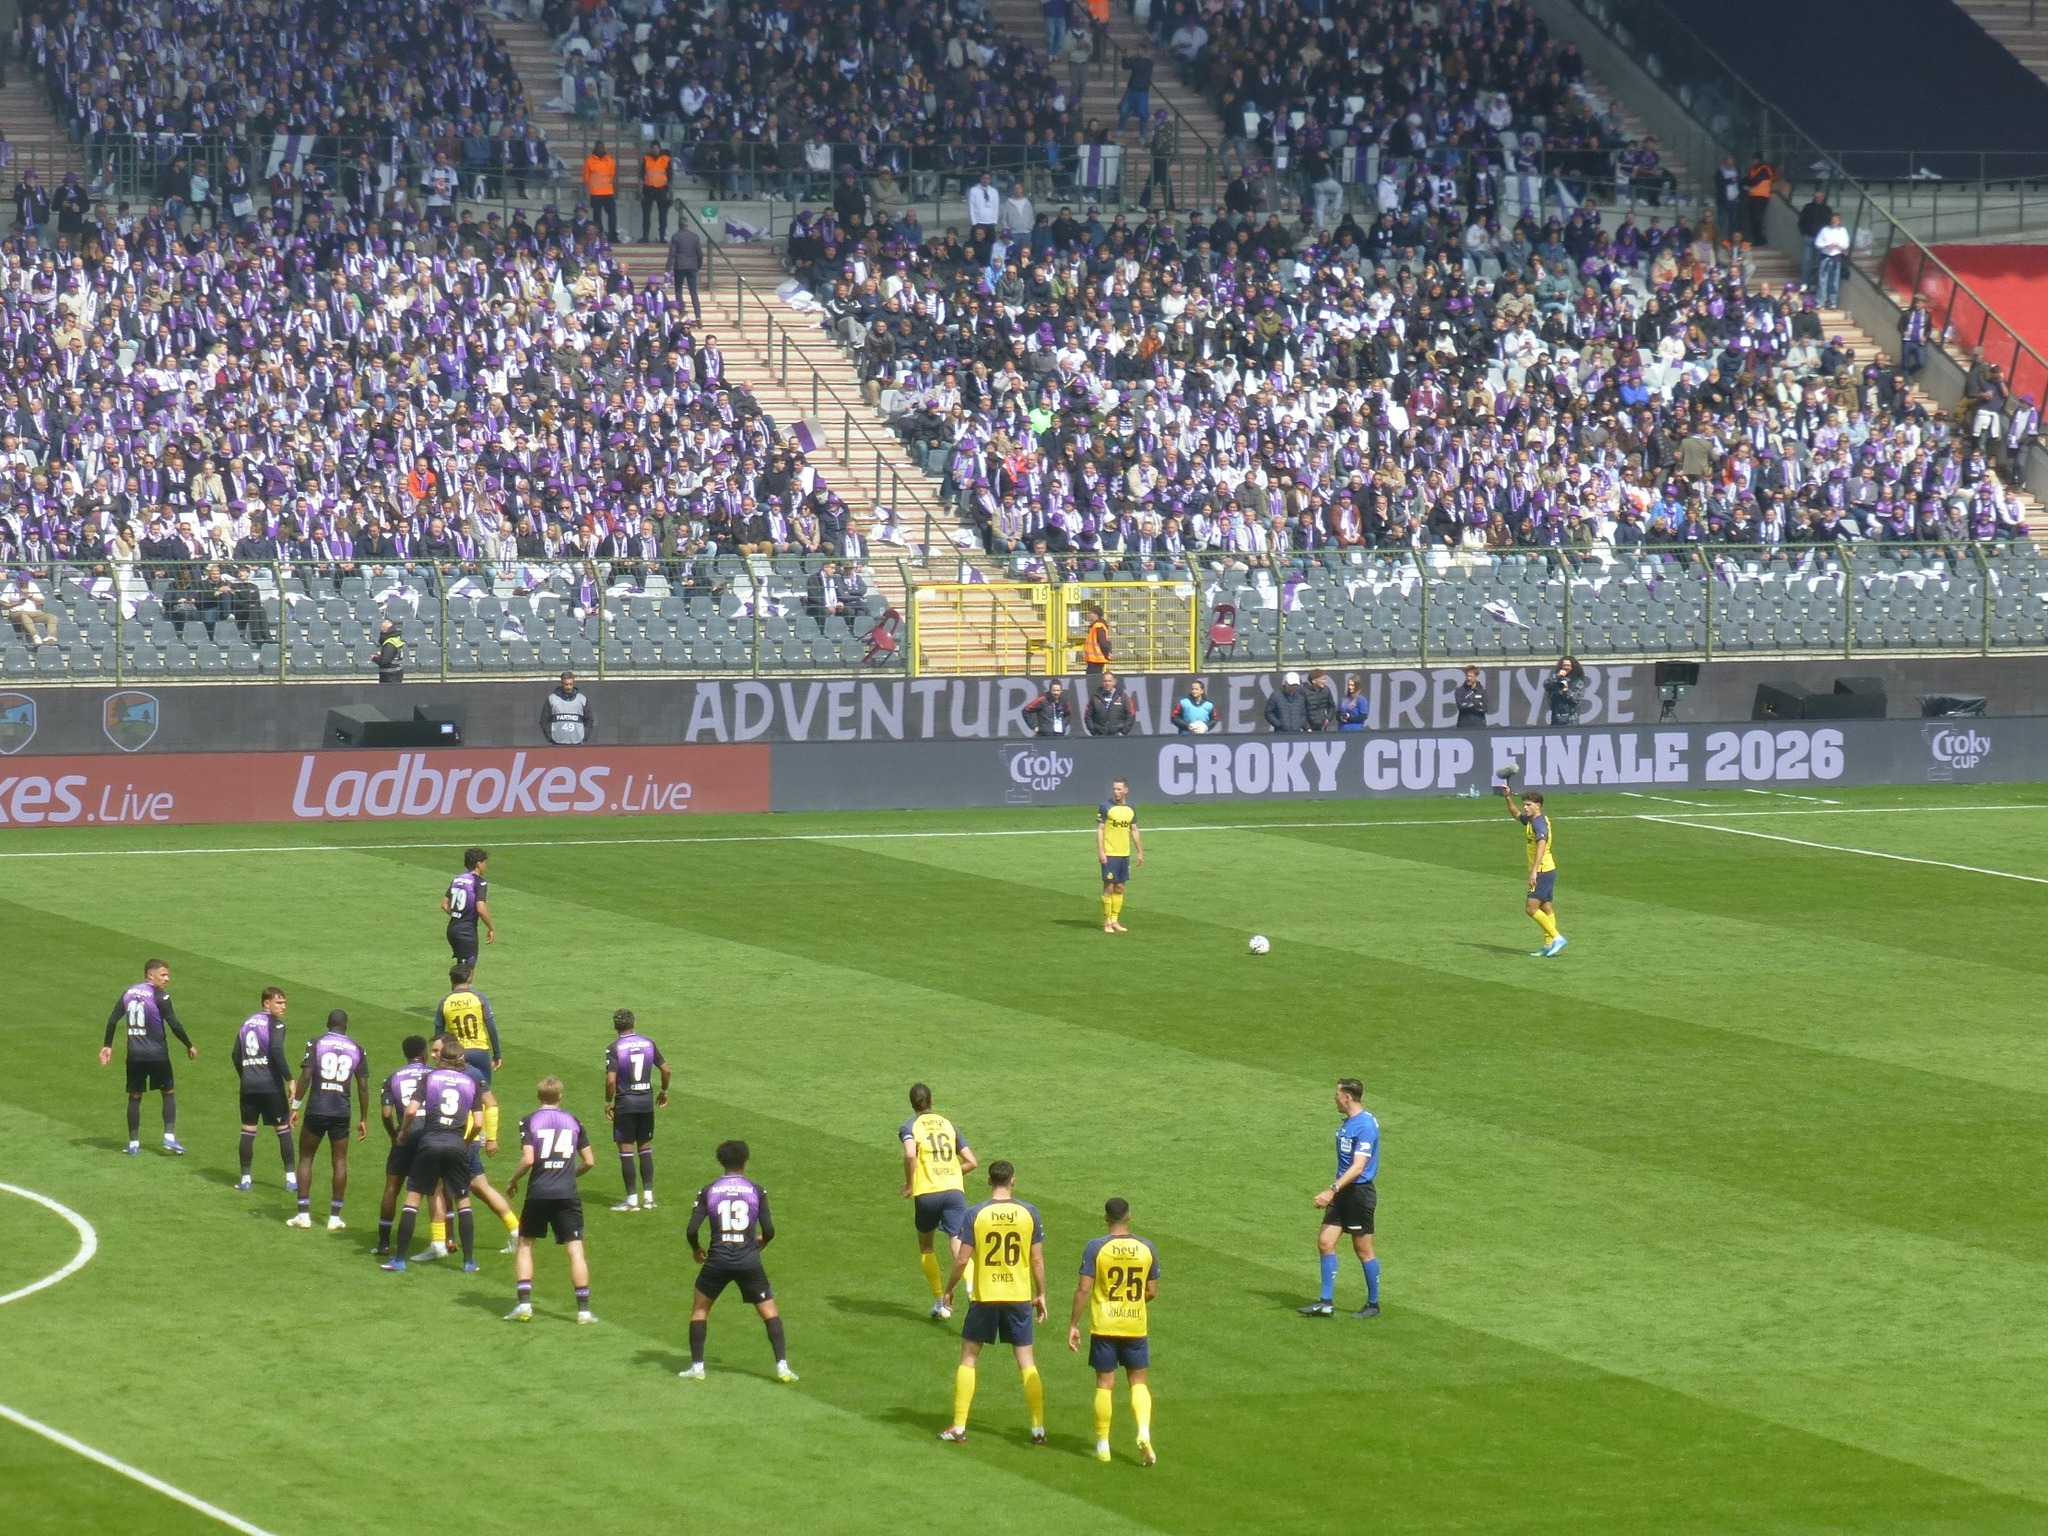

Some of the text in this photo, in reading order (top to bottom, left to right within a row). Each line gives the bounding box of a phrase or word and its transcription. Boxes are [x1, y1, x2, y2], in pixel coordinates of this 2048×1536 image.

[1035, 586, 1048, 601] 19
[1067, 587, 1080, 601] 18
[561, 722, 575, 732] 49
[1931, 729, 1991, 762] Croky
[1010, 750, 1074, 783] Croky
[1158, 728, 1845, 796] CROKY CUP FINALE 2026
[1952, 755, 1980, 769] CUP
[1032, 777, 1061, 791] CUP
[451, 887, 468, 911] 79
[127, 1000, 146, 1027] 11
[453, 1013, 478, 1040] 10
[245, 1030, 260, 1056] 9
[321, 1052, 353, 1082] 93
[630, 1053, 645, 1082] 7
[441, 1088, 460, 1116] 3
[537, 1128, 574, 1159] 74
[926, 1132, 953, 1163] 16
[717, 1199, 750, 1231] 13
[991, 1210, 1018, 1223] hey!
[984, 1231, 1021, 1267] 26
[1112, 1245, 1139, 1257] hey!
[991, 1273, 1015, 1283] SYKES
[1107, 1266, 1144, 1303] 25
